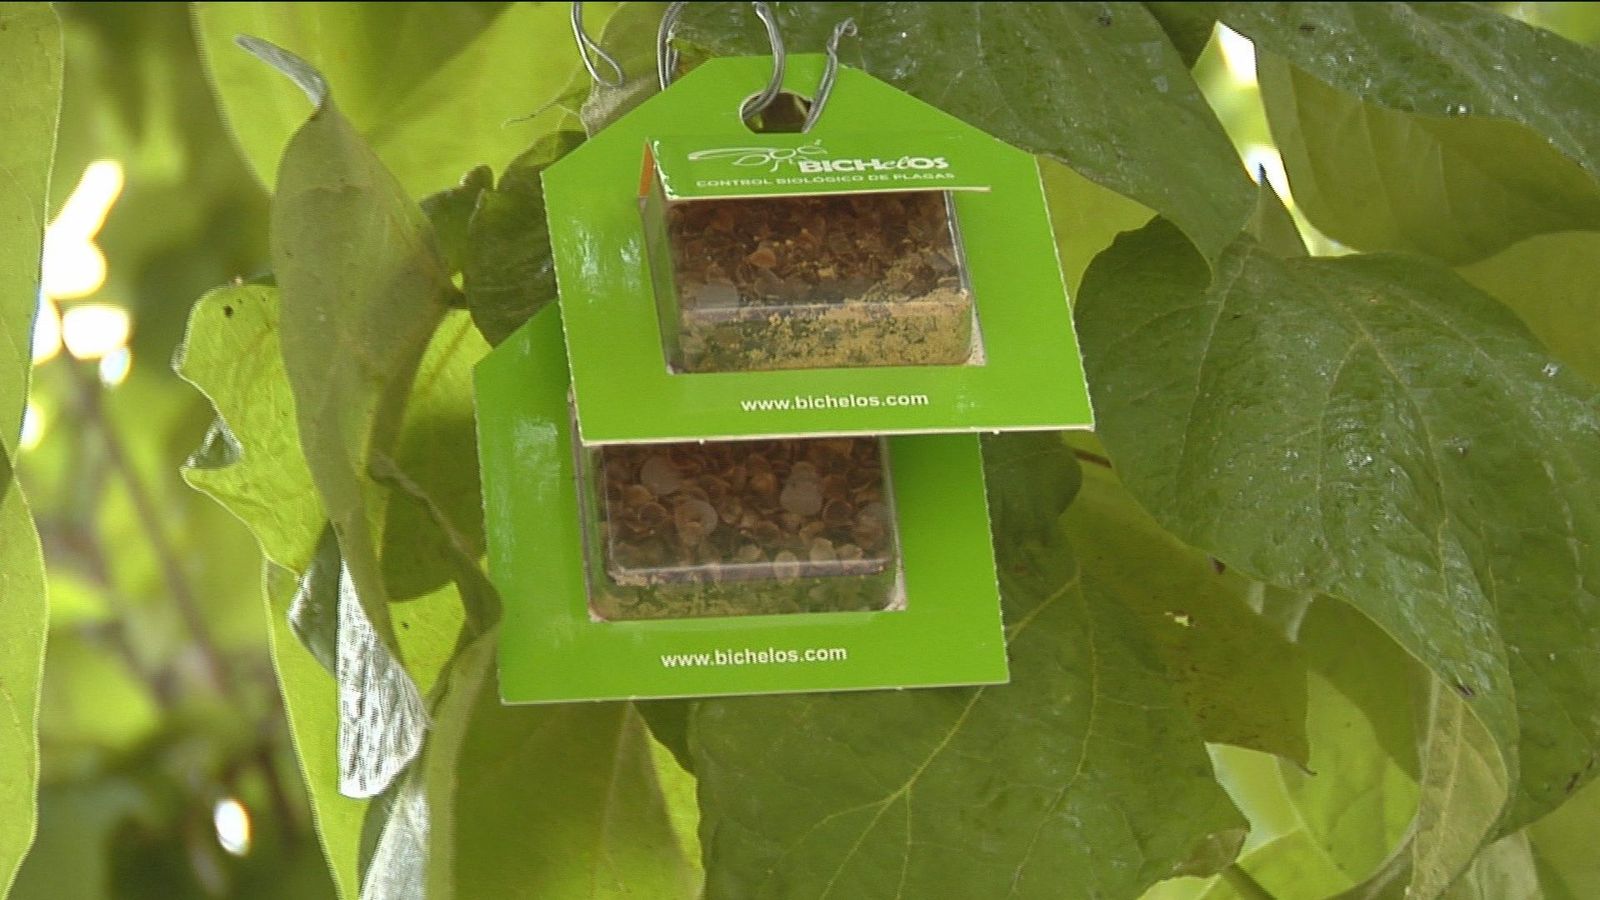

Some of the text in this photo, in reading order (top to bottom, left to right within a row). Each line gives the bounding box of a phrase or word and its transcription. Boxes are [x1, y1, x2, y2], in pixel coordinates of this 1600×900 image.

[696, 172, 955, 188] CONTROL BIOLÓGICO DE PLAGAS
[740, 394, 929, 411] www.bichelos.com
[660, 647, 848, 668] www.bichelos.com
